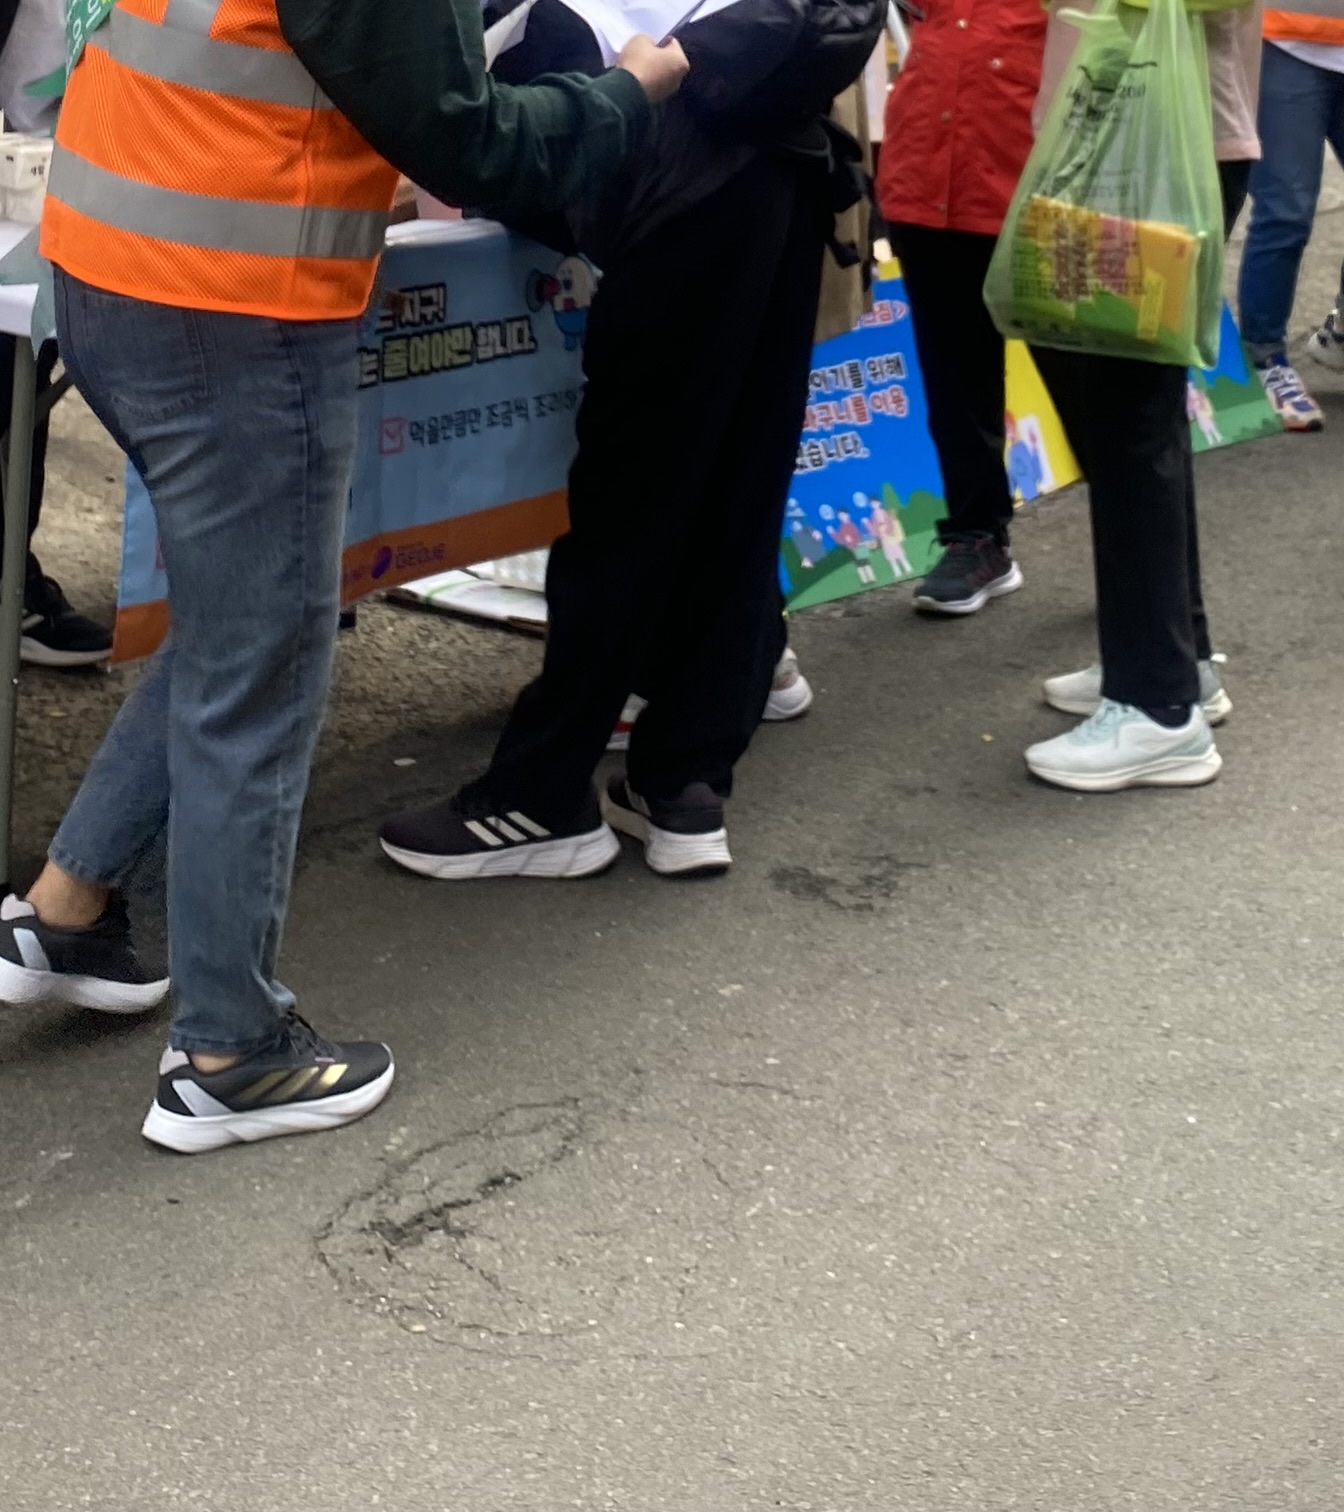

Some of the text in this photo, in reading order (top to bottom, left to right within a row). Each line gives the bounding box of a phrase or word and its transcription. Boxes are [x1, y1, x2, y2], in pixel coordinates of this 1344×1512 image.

[383, 324, 474, 382] 줄여야만
[808, 354, 906, 393] 이기를 위해
[870, 386, 908, 417] 이용
